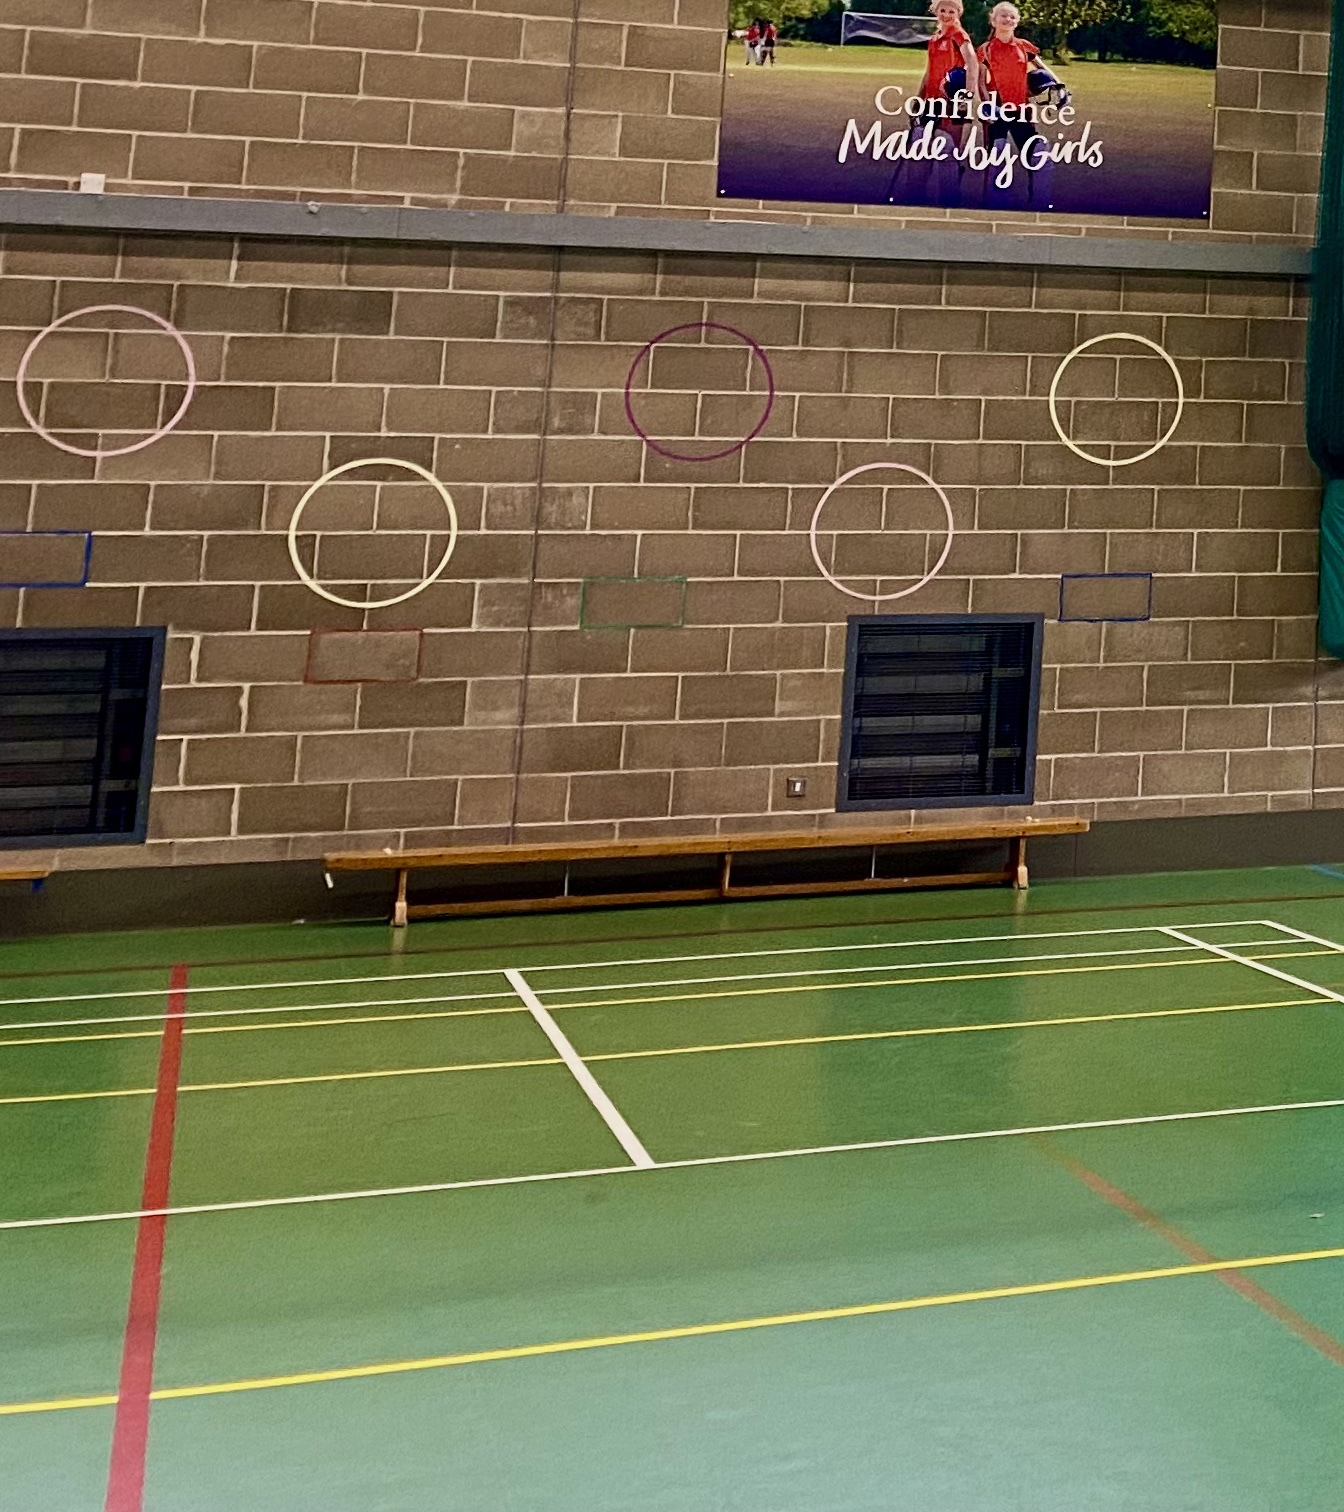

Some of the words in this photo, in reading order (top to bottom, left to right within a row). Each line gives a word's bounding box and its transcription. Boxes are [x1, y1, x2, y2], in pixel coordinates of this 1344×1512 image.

[874, 85, 1076, 126] Confidence
[837, 118, 948, 164] Made
[953, 125, 1017, 189] by
[1020, 121, 1104, 171] Girls
